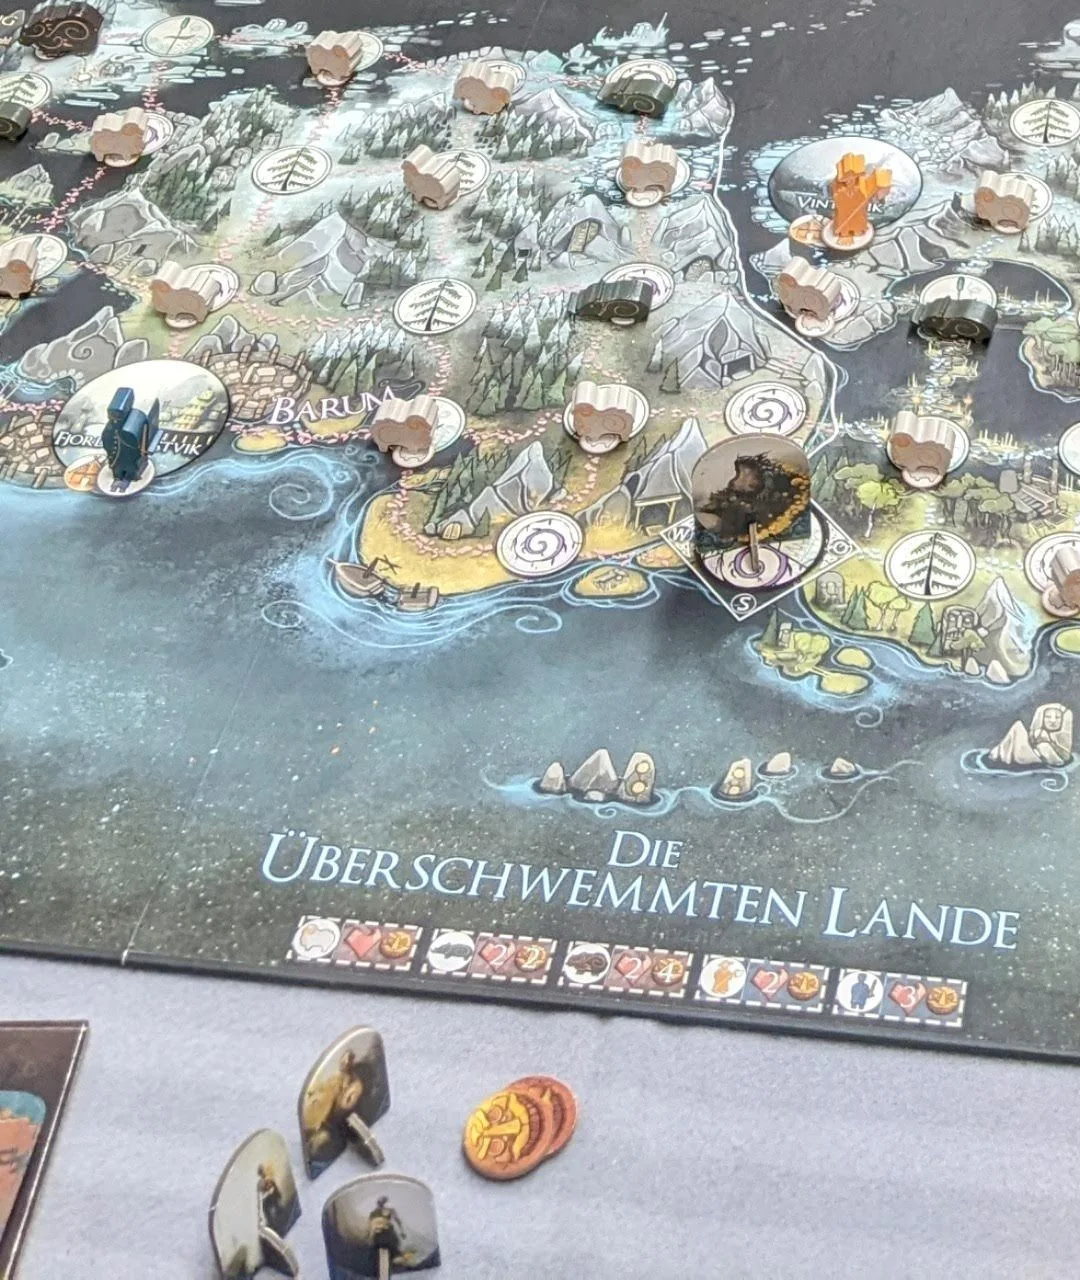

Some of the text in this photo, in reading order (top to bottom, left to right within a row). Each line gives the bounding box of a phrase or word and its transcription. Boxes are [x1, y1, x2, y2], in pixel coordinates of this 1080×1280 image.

[736, 596, 752, 613] S
[607, 830, 683, 870] DIE
[261, 827, 1021, 951] ÜBERSCHWEMMTEN LANDE
